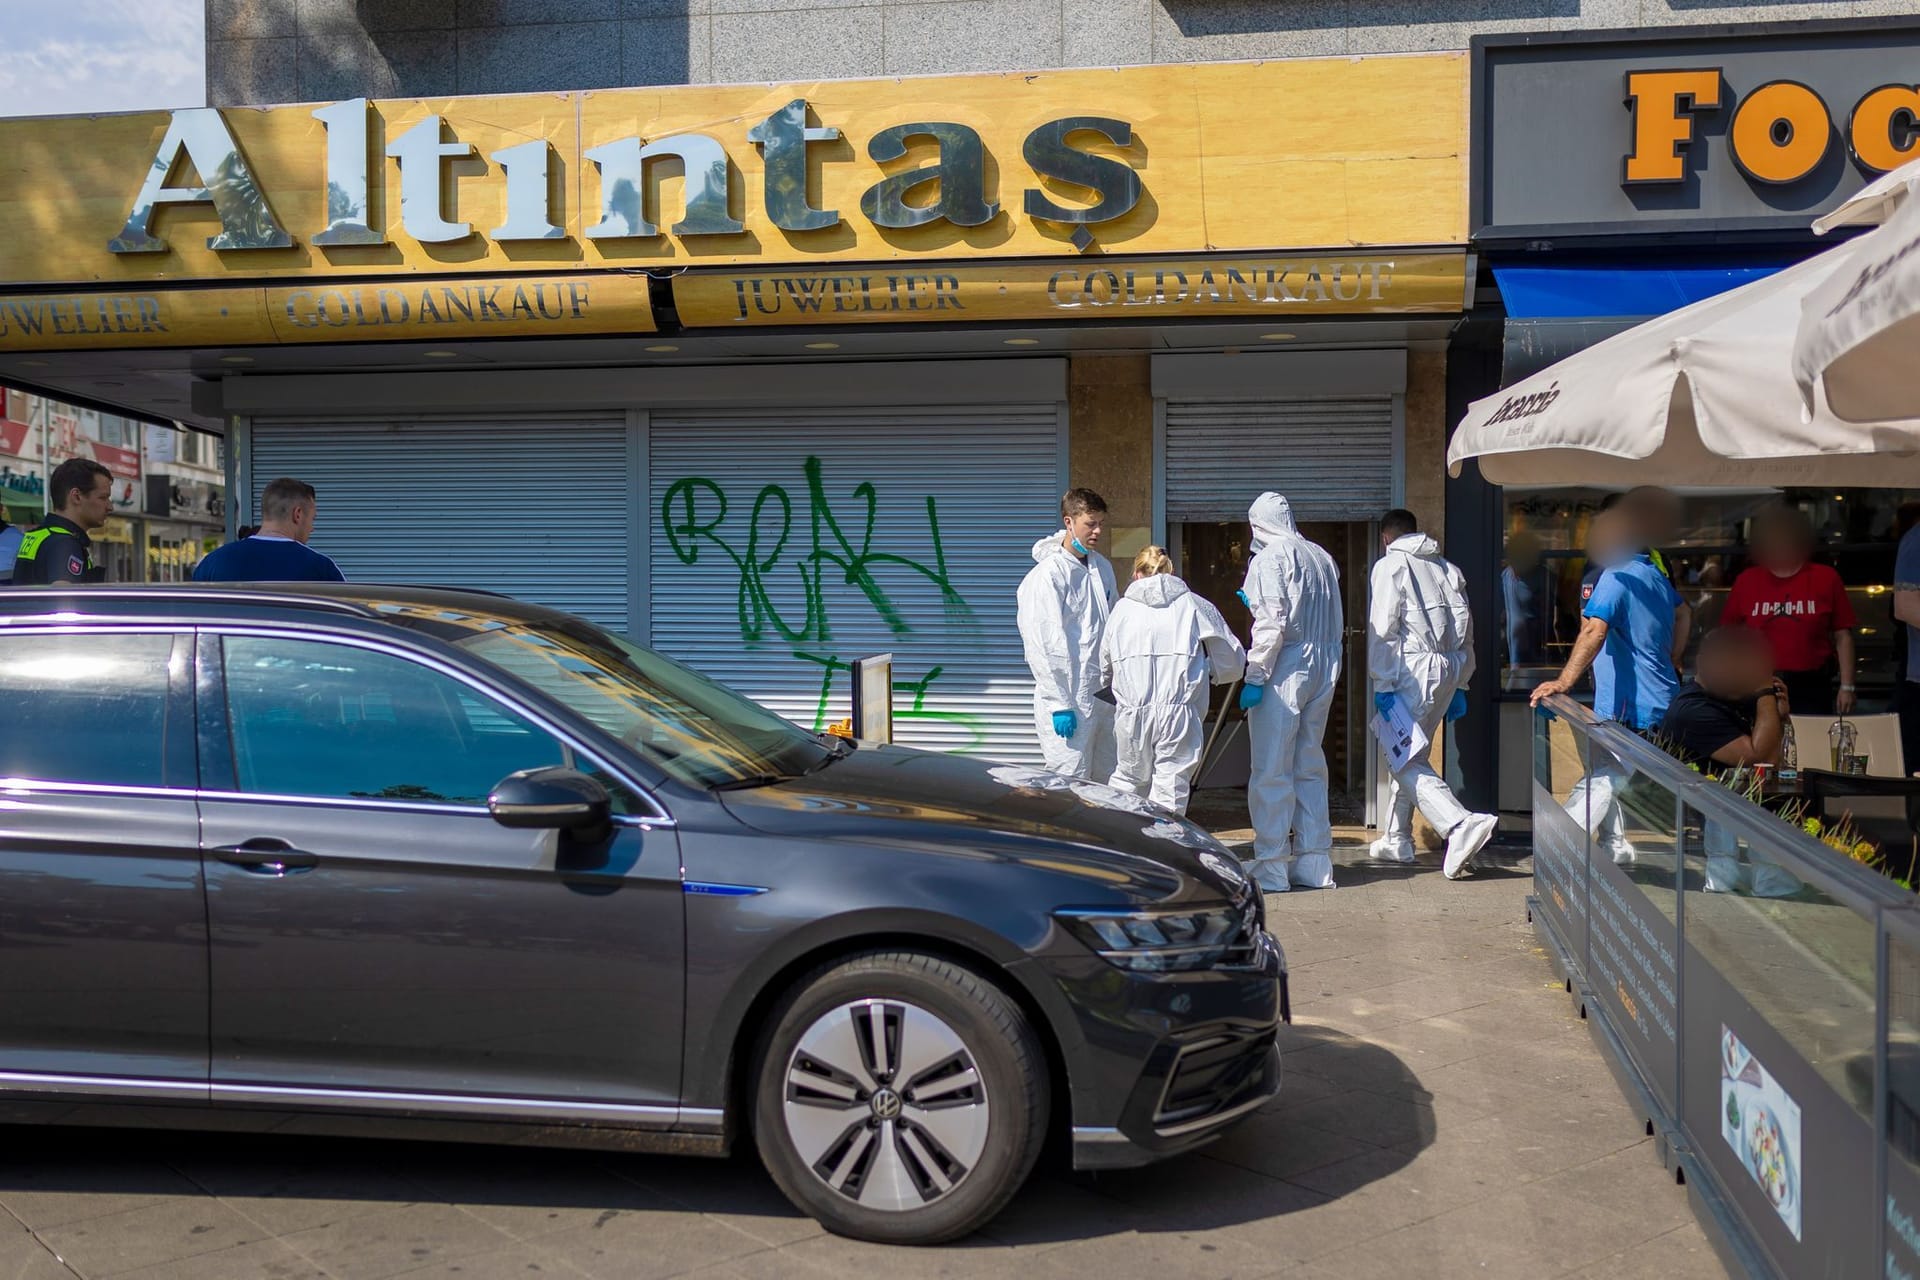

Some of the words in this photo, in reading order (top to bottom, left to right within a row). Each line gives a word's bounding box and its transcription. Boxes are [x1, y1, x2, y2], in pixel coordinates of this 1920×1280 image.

[286, 281, 590, 328] GOLDANKAUF
[732, 273, 967, 321] JUWELIER
[1047, 261, 1396, 309] GOLDANKAUF
